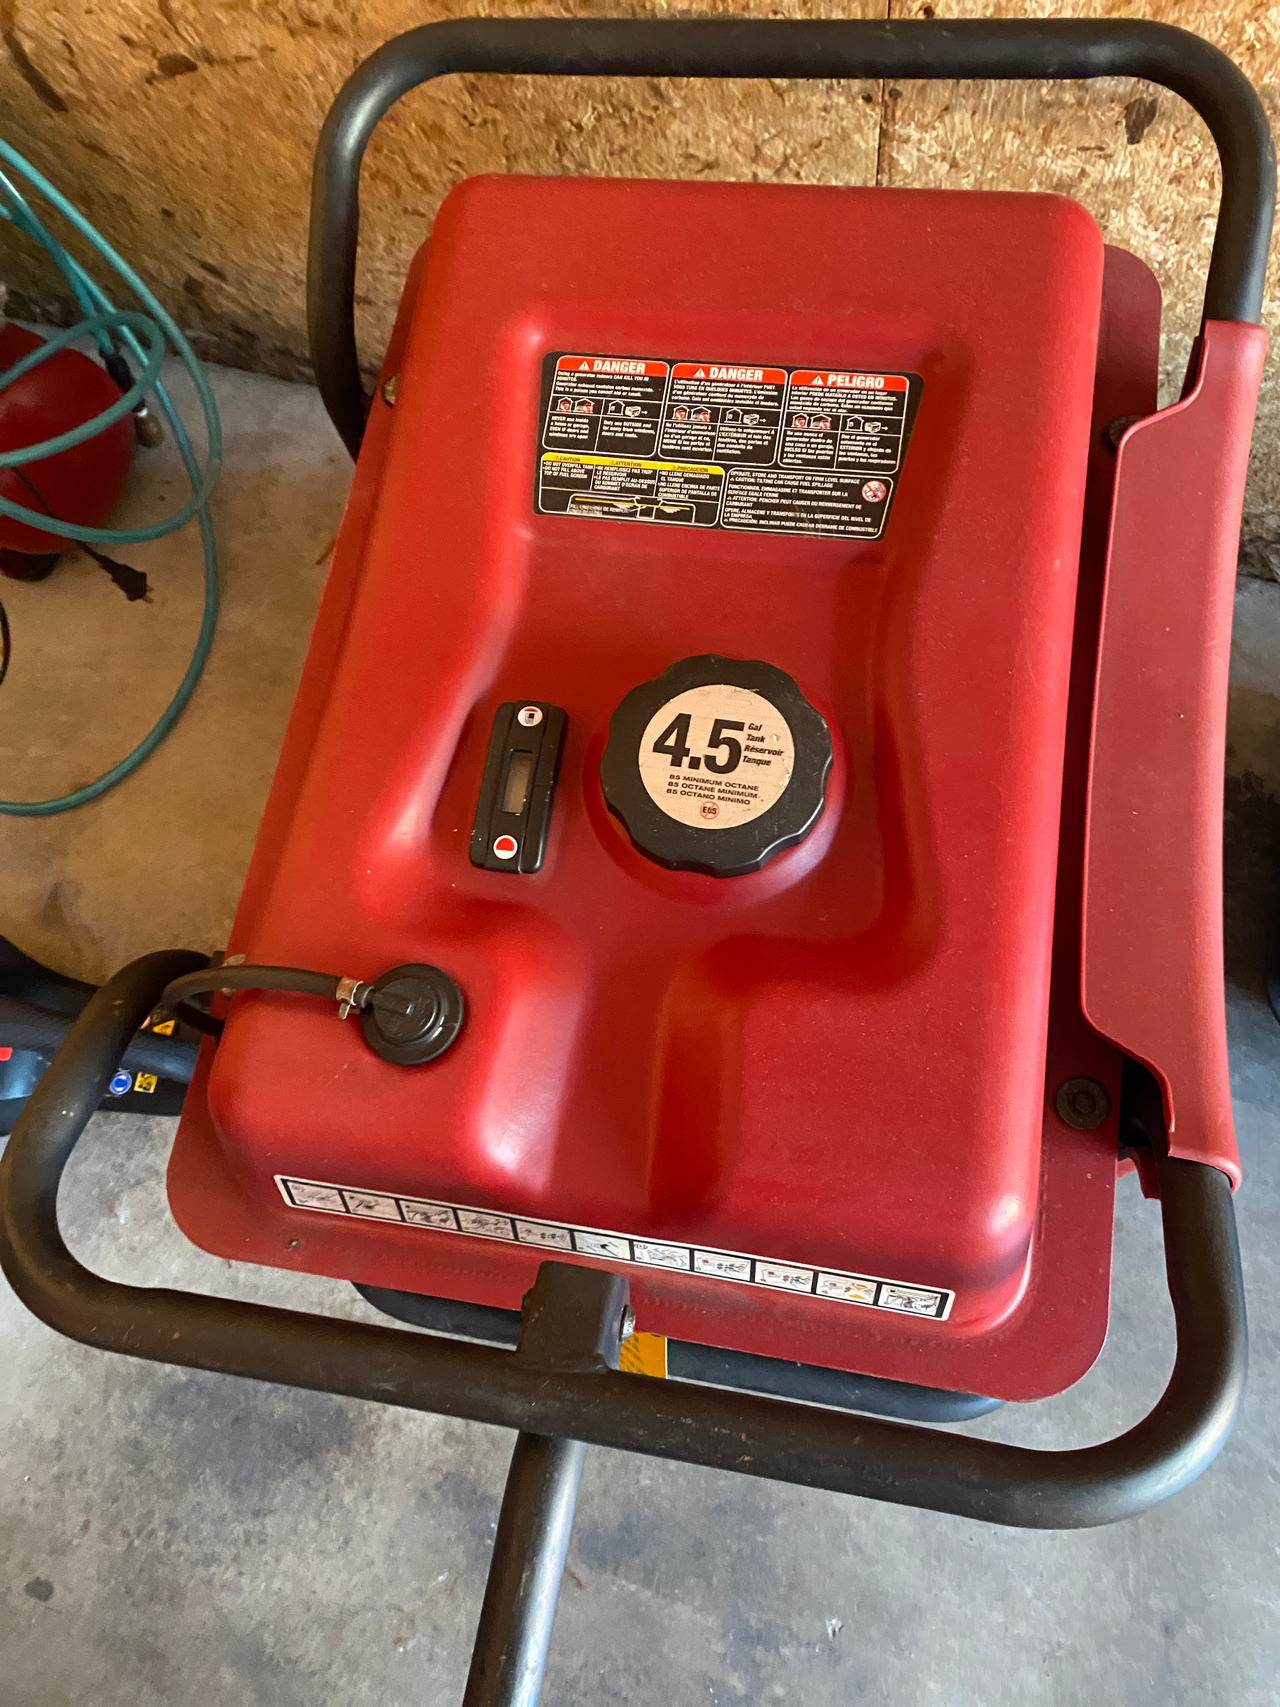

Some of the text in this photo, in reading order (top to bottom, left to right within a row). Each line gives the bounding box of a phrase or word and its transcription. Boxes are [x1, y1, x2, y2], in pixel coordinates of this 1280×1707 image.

[593, 360, 646, 374] DANGER
[709, 367, 763, 382] DANGER
[827, 374, 885, 389] PELIGRO
[748, 723, 763, 732] Gal
[652, 713, 745, 775] 4.5
[746, 734, 766, 743] Tank
[743, 756, 772, 766] Tanque
[681, 783, 715, 793] OCTANE
[717, 788, 758, 799] MINIMUM
[682, 776, 722, 786] MINIMUM
[725, 782, 759, 792] OCTANE
[680, 791, 715, 800] OCTANO
[717, 796, 751, 805] MINIMO
